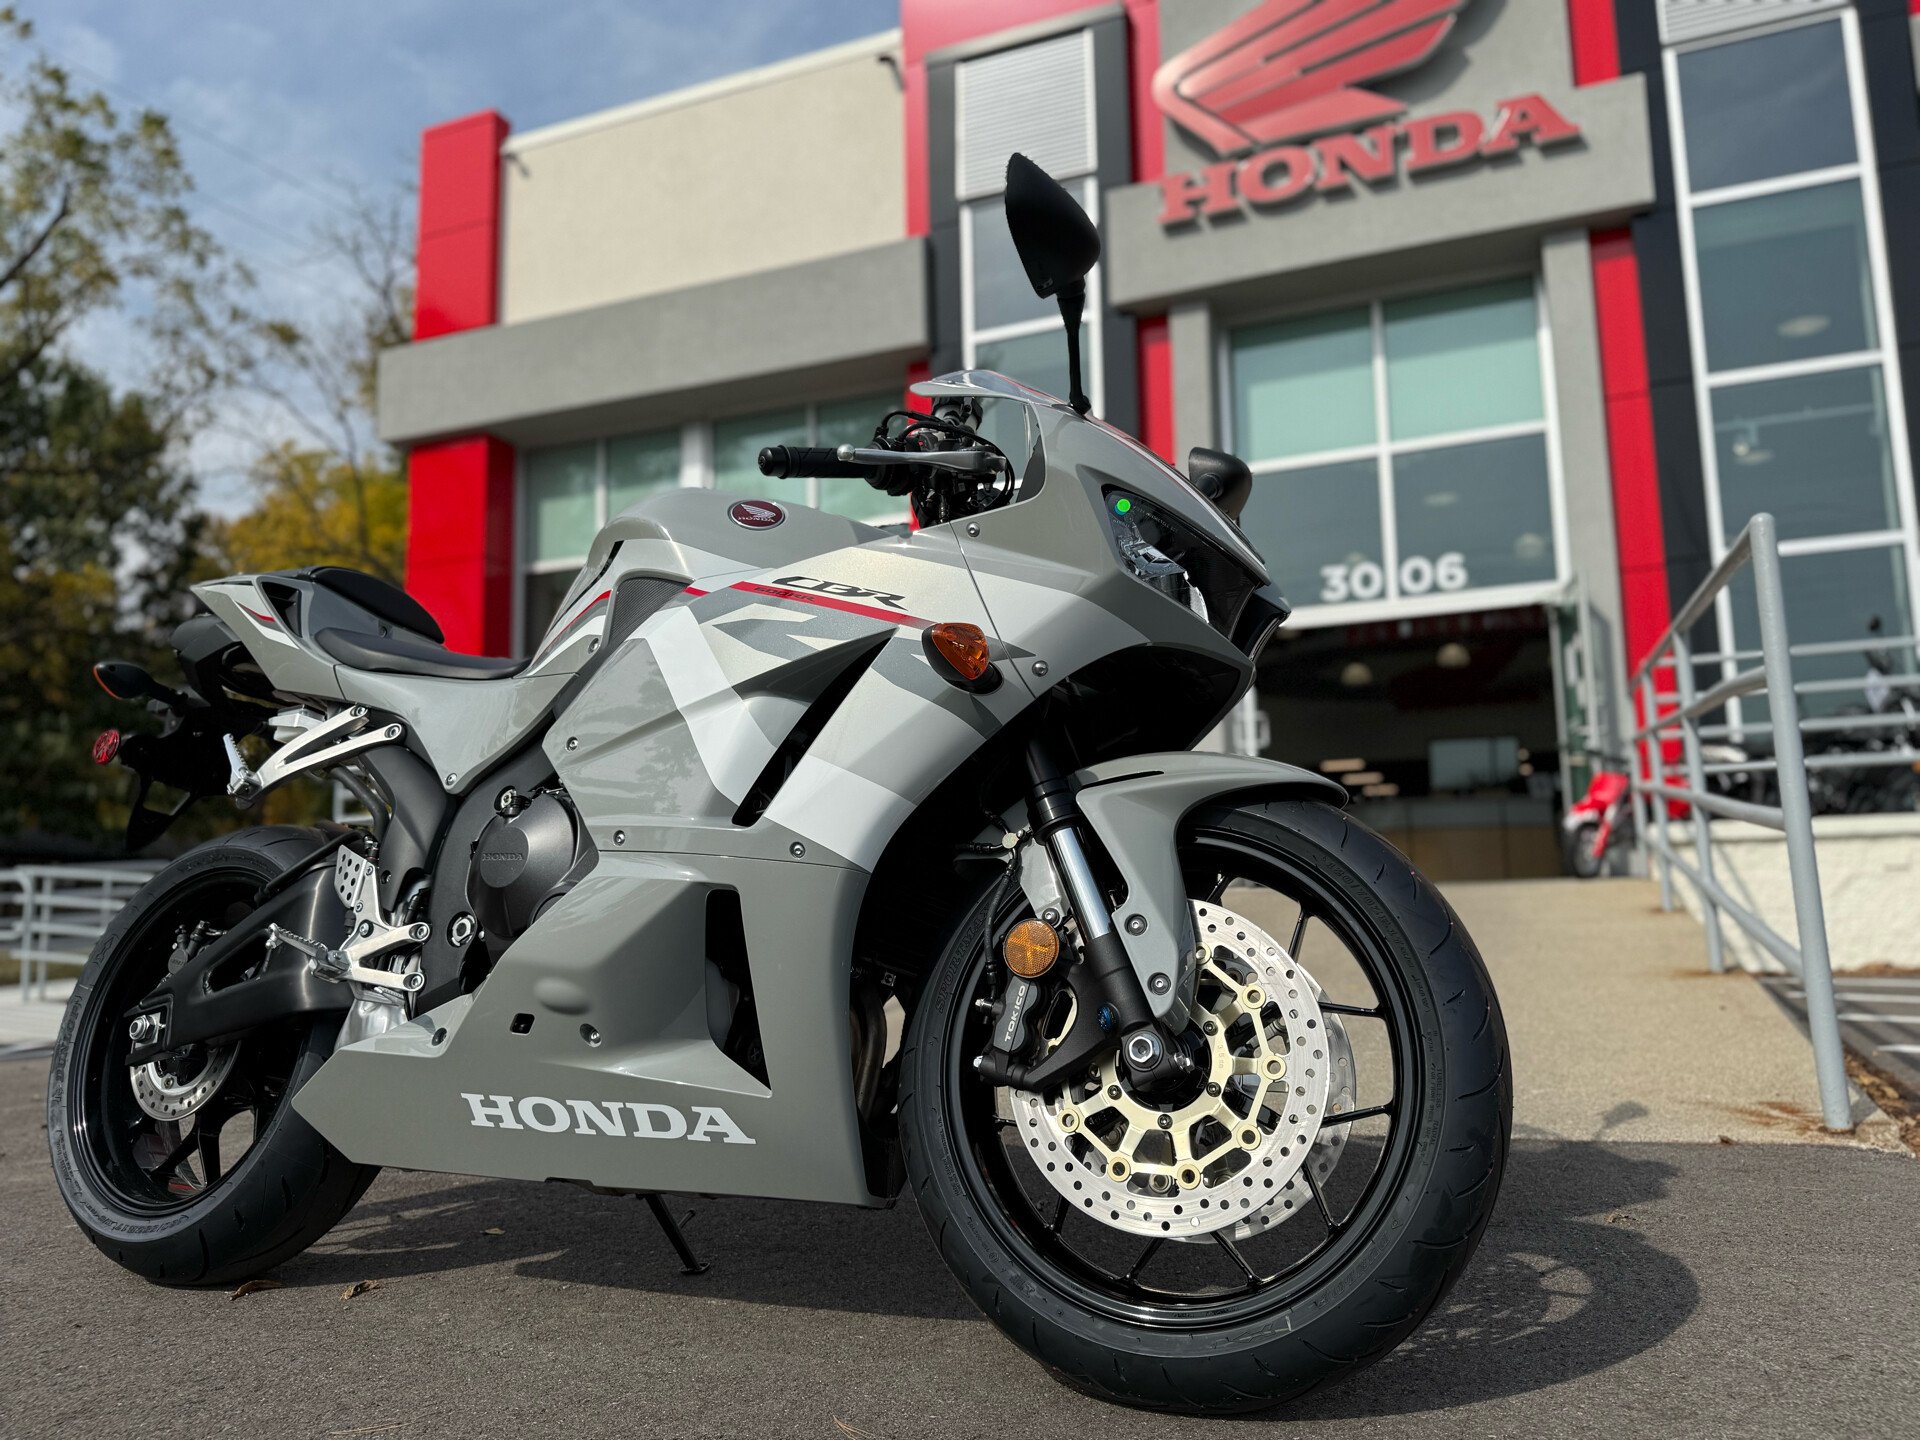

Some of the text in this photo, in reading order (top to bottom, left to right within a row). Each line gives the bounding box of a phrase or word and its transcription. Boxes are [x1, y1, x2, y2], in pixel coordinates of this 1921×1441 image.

[1158, 93, 1582, 224] HONDA
[754, 587, 815, 601] 600RR
[772, 576, 908, 611] CBR
[482, 852, 523, 861] HONDA
[1004, 985, 1025, 1042] TOKICO
[460, 1092, 757, 1145] HONDA
